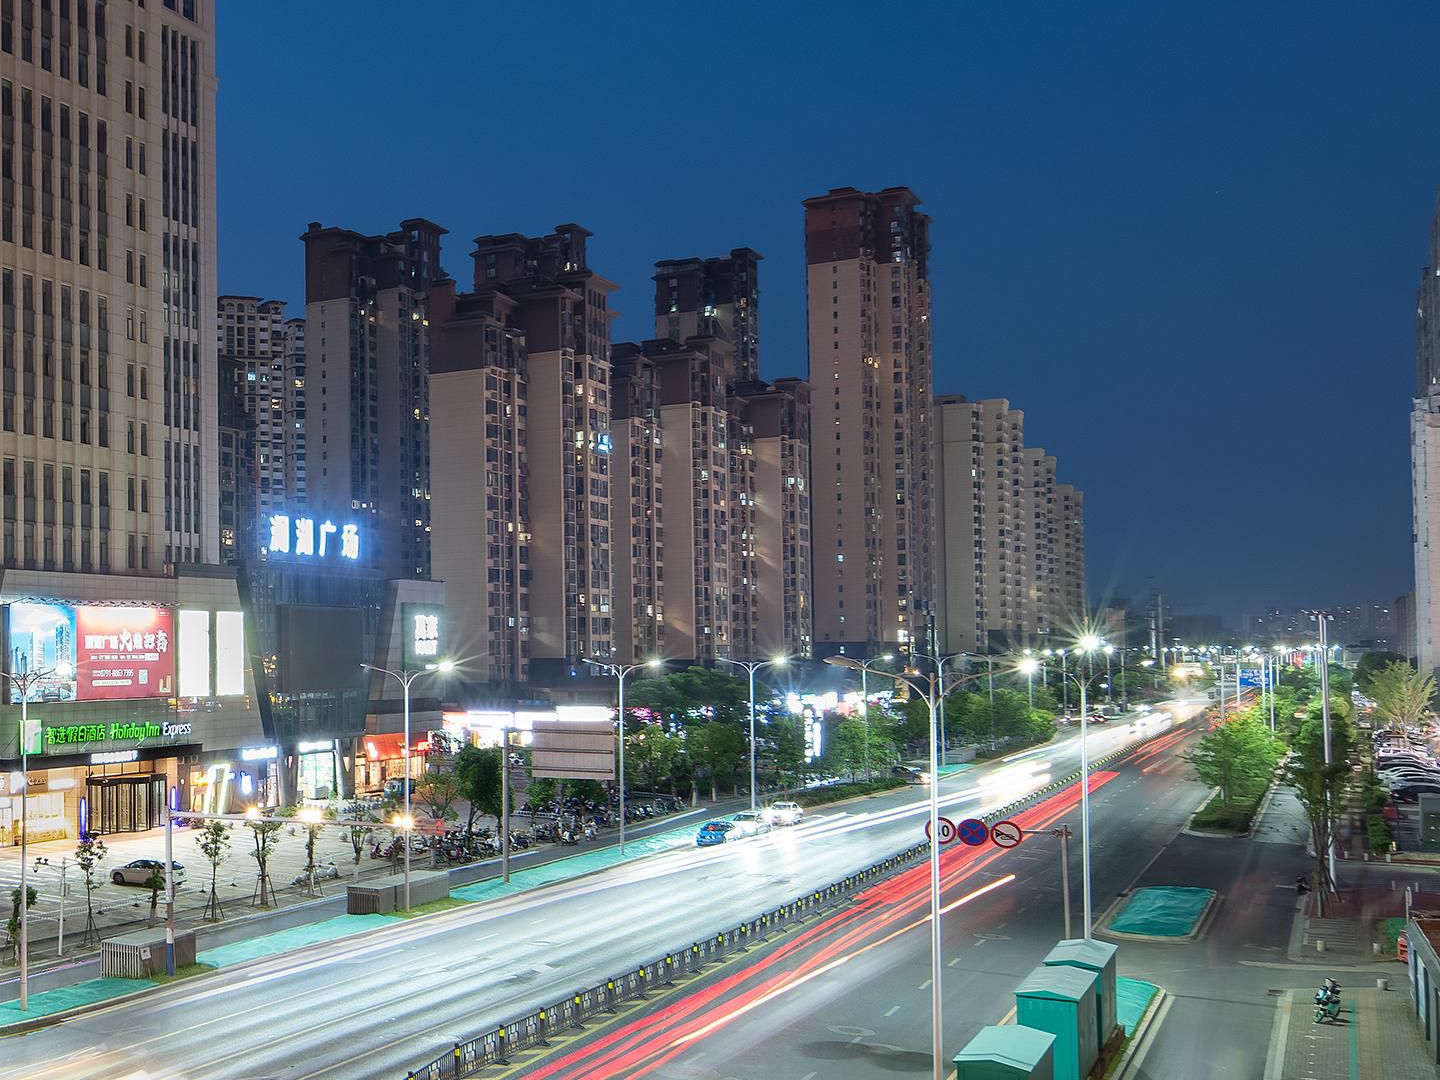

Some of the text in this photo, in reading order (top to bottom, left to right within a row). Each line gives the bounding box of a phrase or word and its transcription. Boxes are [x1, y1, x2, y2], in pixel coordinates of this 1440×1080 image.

[45, 723, 106, 745] 智选假日酒店
[162, 721, 193, 739] Express
